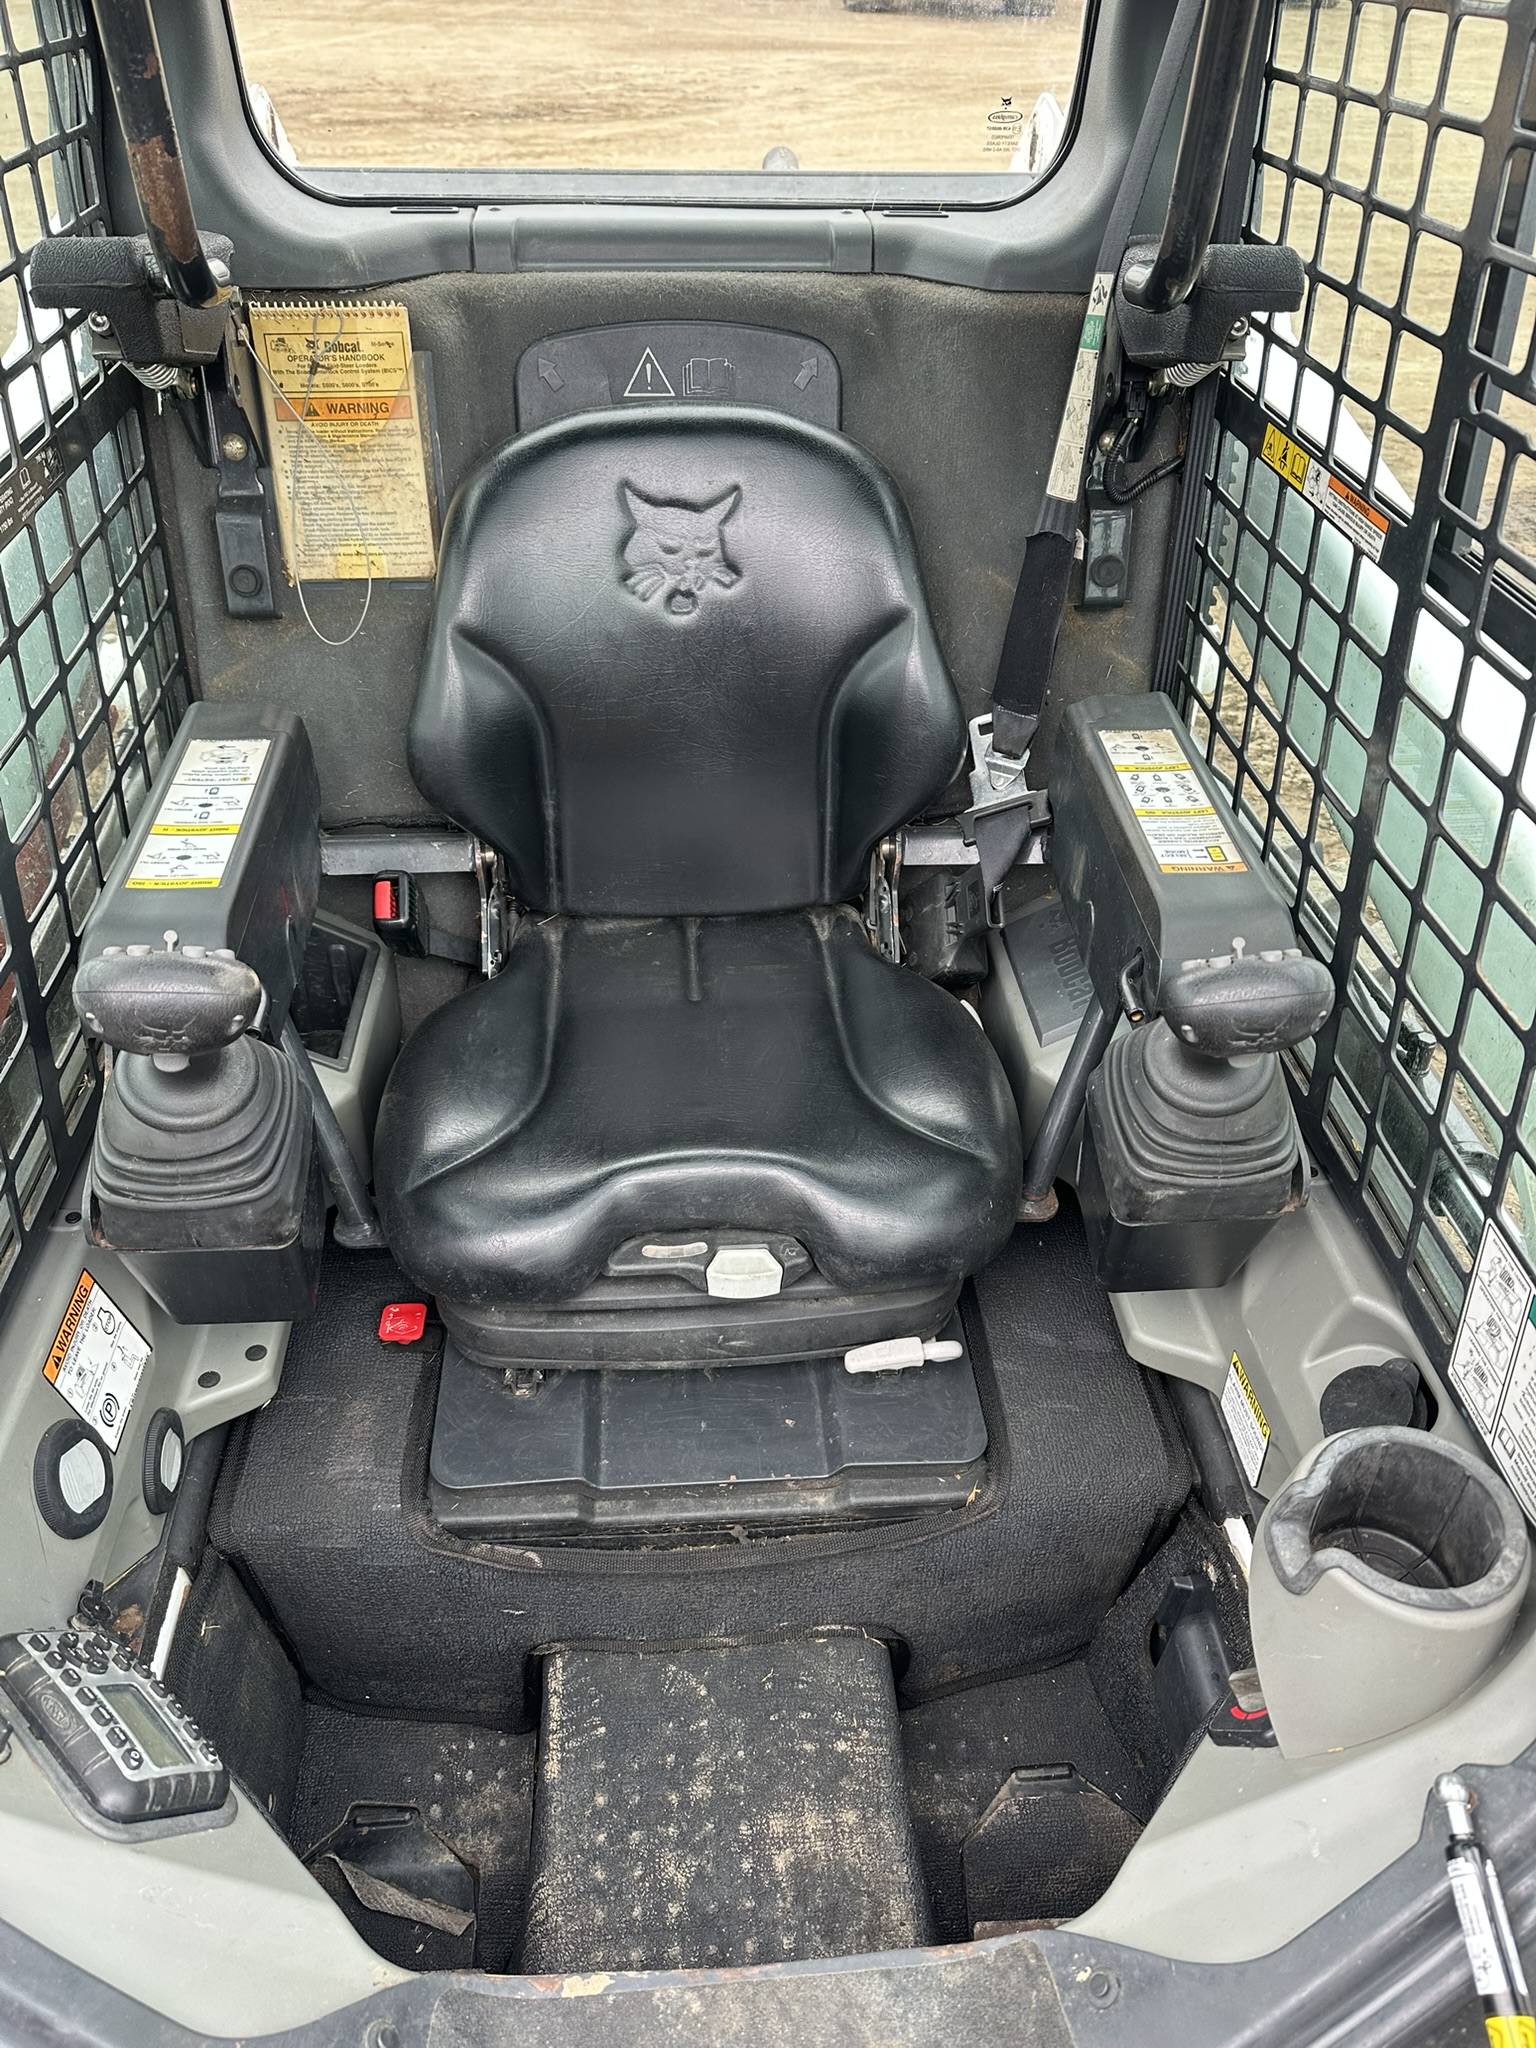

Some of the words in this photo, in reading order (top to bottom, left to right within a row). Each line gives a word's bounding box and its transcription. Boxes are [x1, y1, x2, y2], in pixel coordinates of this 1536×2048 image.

[324, 340, 361, 353] Bobcat
[287, 354, 337, 362] OPERAOR'S
[339, 353, 386, 362] HANDBOOK
[326, 402, 390, 414] WARNING
[1349, 493, 1370, 517] WARNING
[55, 1282, 89, 1355] WARNING
[103, 1313, 112, 1332] STOP
[62, 1352, 71, 1372] AVOID
[69, 1329, 80, 1352] INJURY
[82, 1298, 92, 1319] DEATH
[71, 1345, 81, 1365] LEAVE
[1238, 1368, 1268, 1440] WARNING
